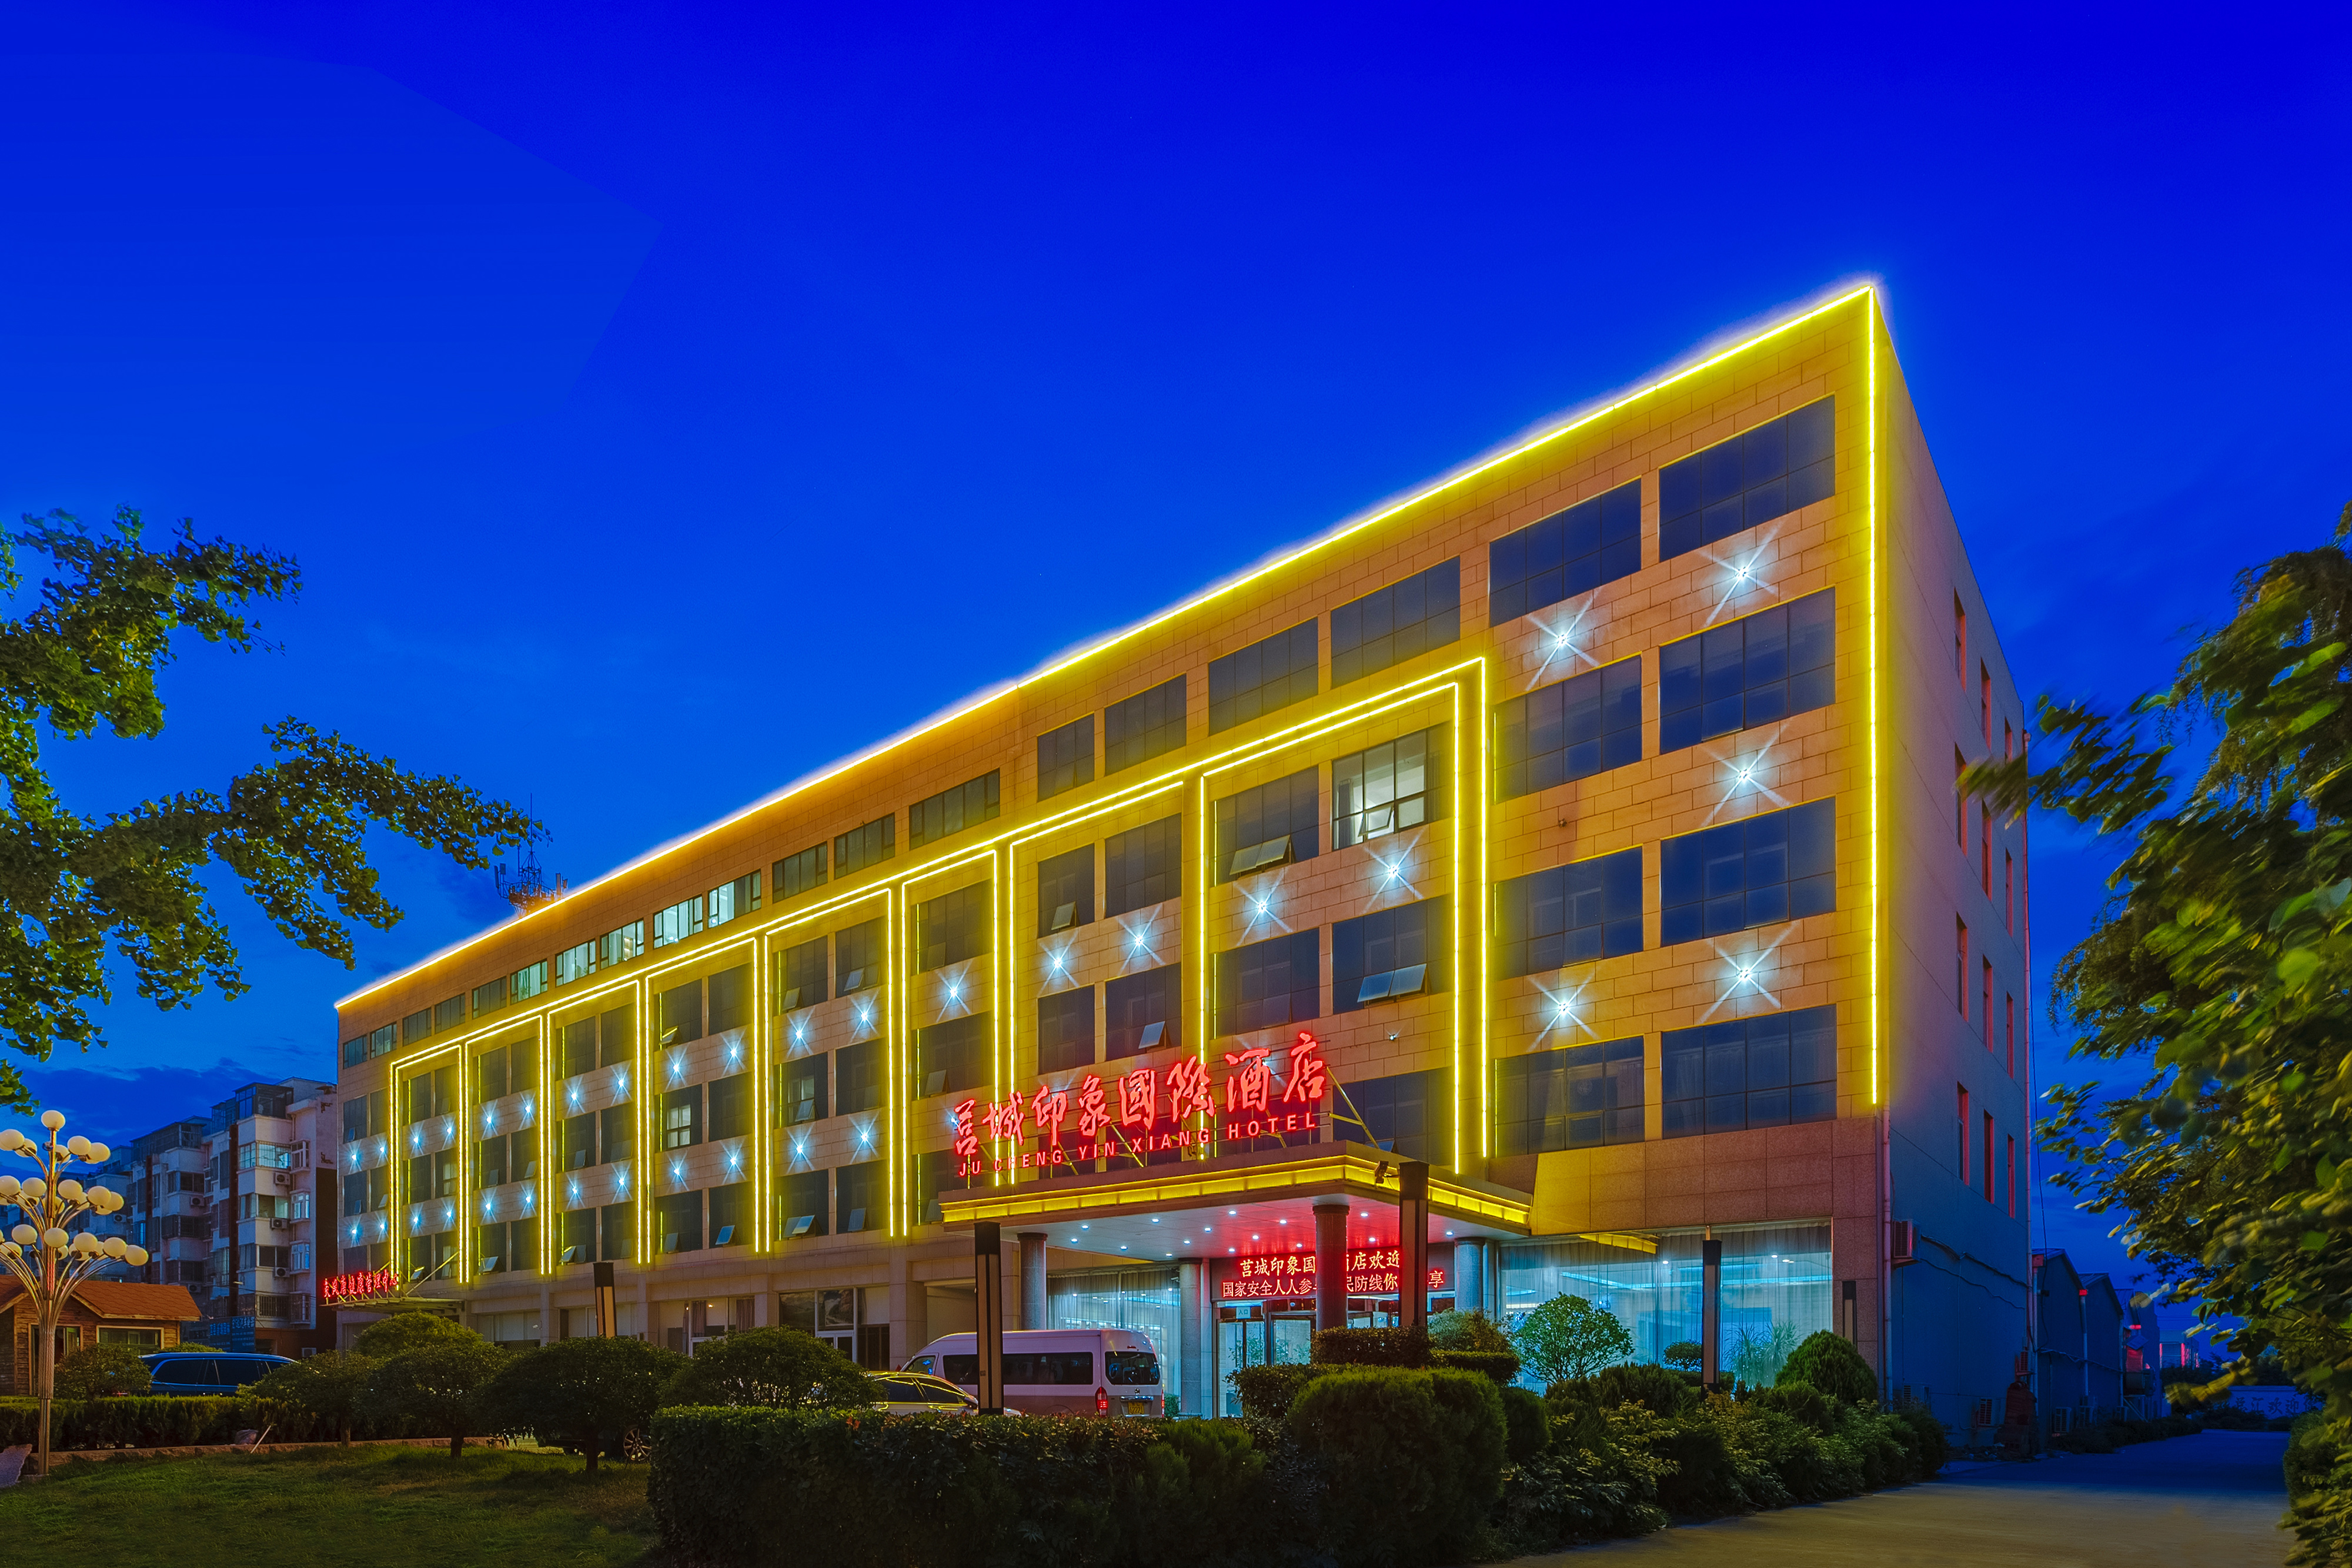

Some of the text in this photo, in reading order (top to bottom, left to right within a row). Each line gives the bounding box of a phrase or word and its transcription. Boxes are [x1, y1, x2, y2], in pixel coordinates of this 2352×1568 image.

[959, 1112, 1315, 1176] JU CHENG YIN XIANG HOTEL
